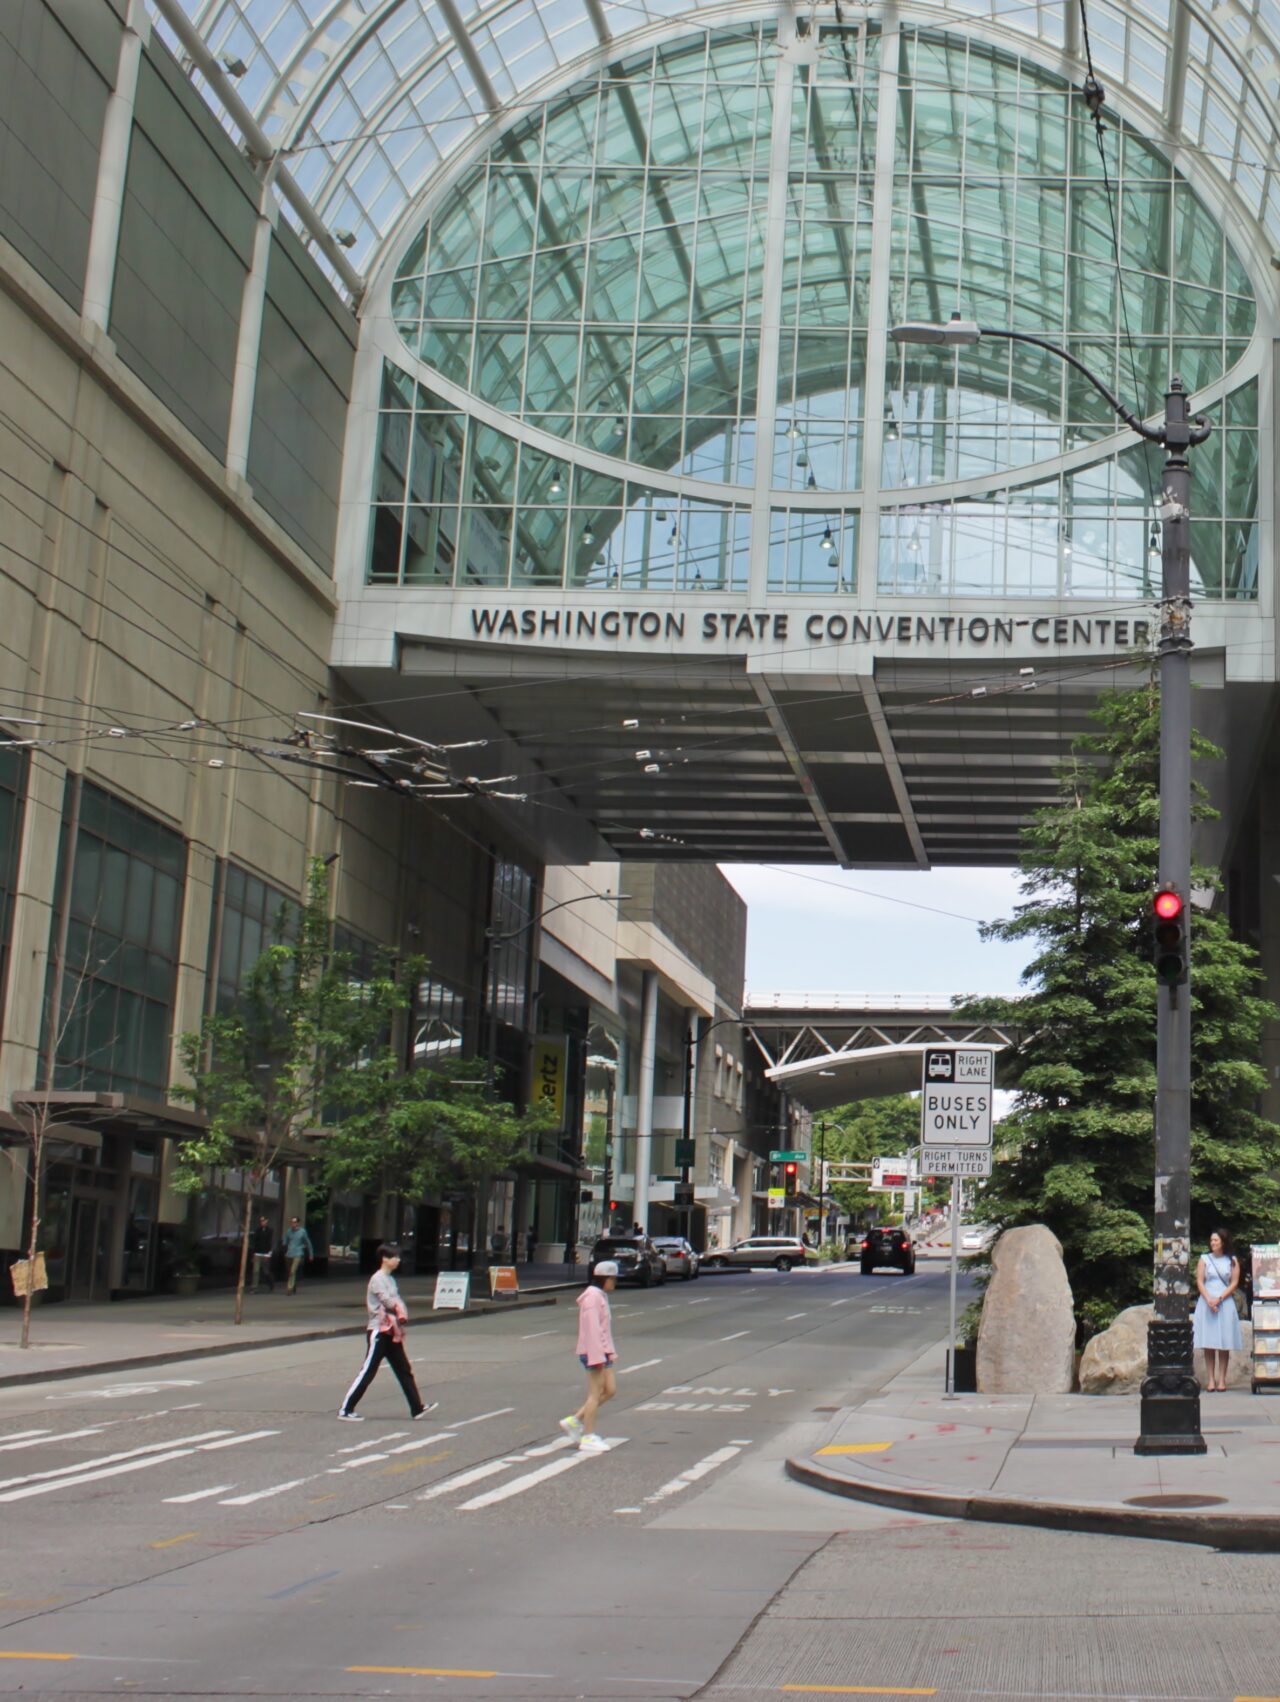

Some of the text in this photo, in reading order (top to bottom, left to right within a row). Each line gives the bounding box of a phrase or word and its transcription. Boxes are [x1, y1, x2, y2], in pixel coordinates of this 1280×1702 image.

[472, 608, 1150, 646] WASHINGTON STATE CONVENTION CENTER
[958, 1055, 989, 1066] RIGHT
[960, 1067, 987, 1077] LANE
[928, 1096, 988, 1112] BUSES
[934, 1114, 980, 1130] ONLY
[924, 1151, 988, 1161] RIGHT TURNS
[928, 1162, 984, 1173] PERMITTED
[661, 1386, 796, 1397] ONLY
[634, 1402, 752, 1412] BUS
